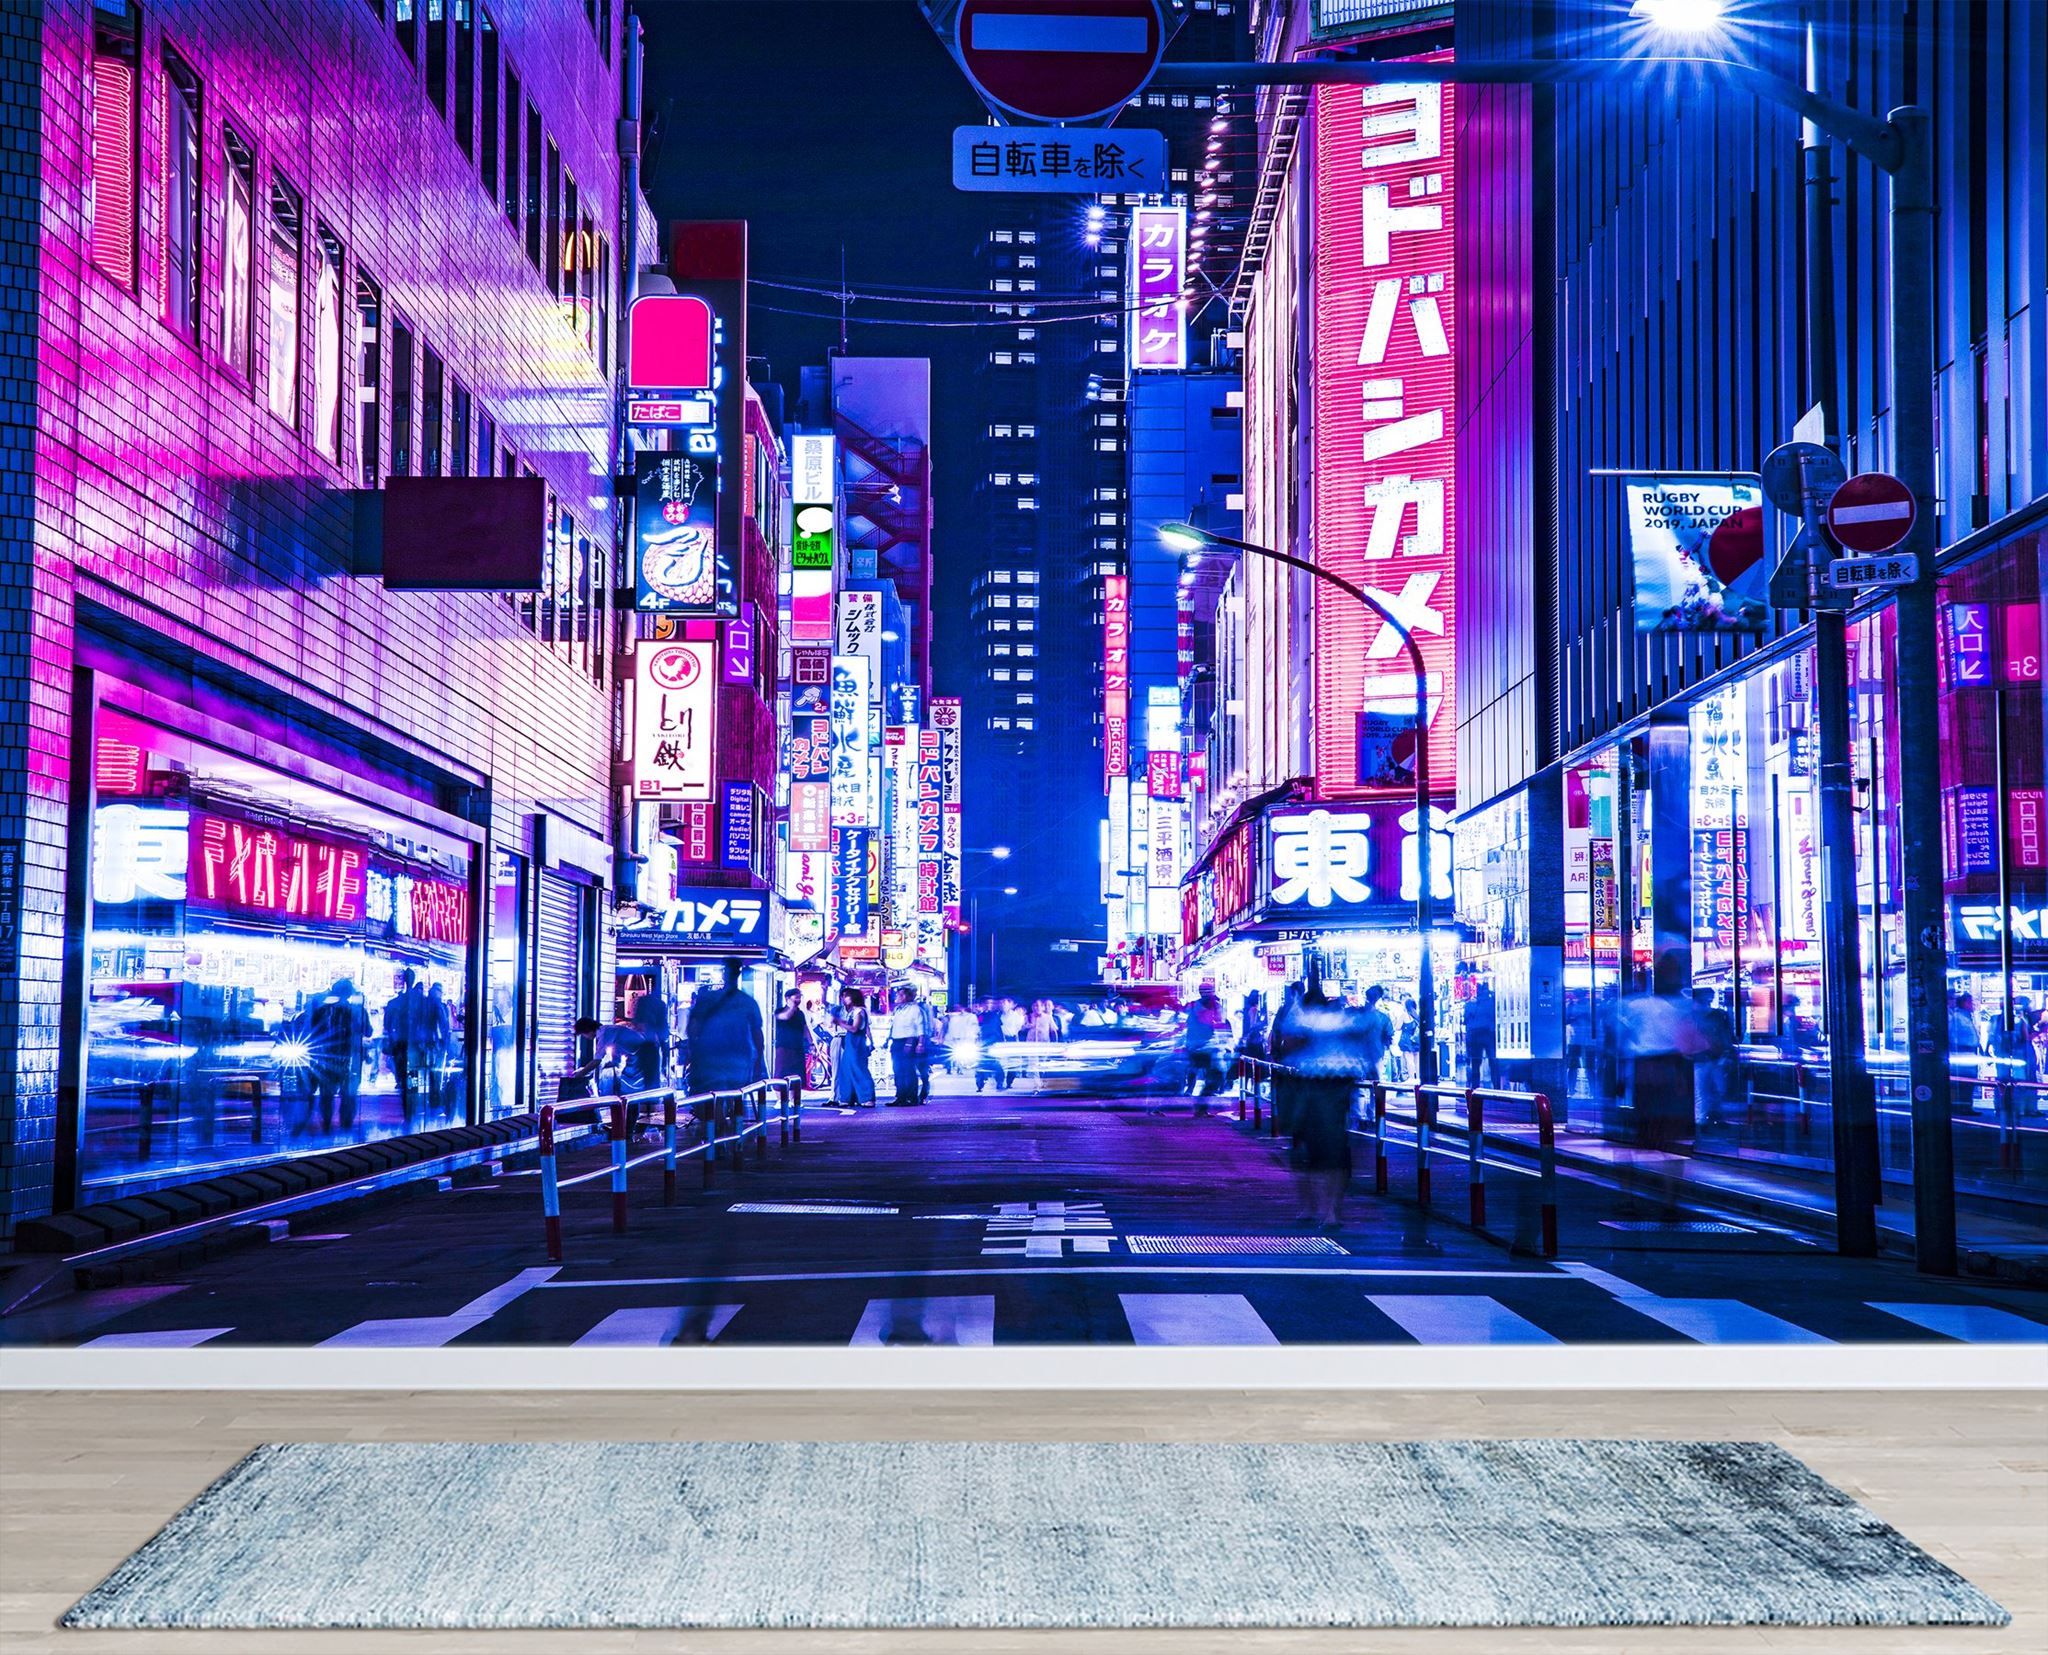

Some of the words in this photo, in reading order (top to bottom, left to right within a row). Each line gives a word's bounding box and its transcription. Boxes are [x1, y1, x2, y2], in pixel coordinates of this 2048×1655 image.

[971, 141, 1145, 179] 自転車を除く
[1141, 224, 1176, 353] カラオケ
[634, 405, 680, 419] たばこ
[804, 440, 823, 500] 桑原ビル
[1643, 492, 1700, 504] RUGBY
[1644, 506, 1702, 517] WORLD
[1707, 504, 1743, 516] CUP
[1645, 518, 1685, 531] 2019,
[1689, 518, 1744, 530] JAPAN
[1836, 562, 1911, 584] 自転車を除く
[640, 592, 670, 609] 4F
[864, 603, 877, 633] 株式会社
[845, 609, 862, 655] シムック
[1106, 598, 1126, 690] カラオケ
[814, 703, 827, 711] 2F
[1108, 717, 1121, 739] BIG
[793, 738, 809, 778] カメラ
[811, 720, 829, 774] ヨドバシ
[1108, 740, 1121, 773] ECHO
[640, 780, 660, 790] B1
[919, 731, 940, 851] ヨドバシカメラ
[1156, 815, 1173, 878] 三平酒寮
[844, 829, 862, 935] ケータイアクセサリー館
[919, 863, 938, 912] 時計館
[660, 898, 762, 933] カメラ
